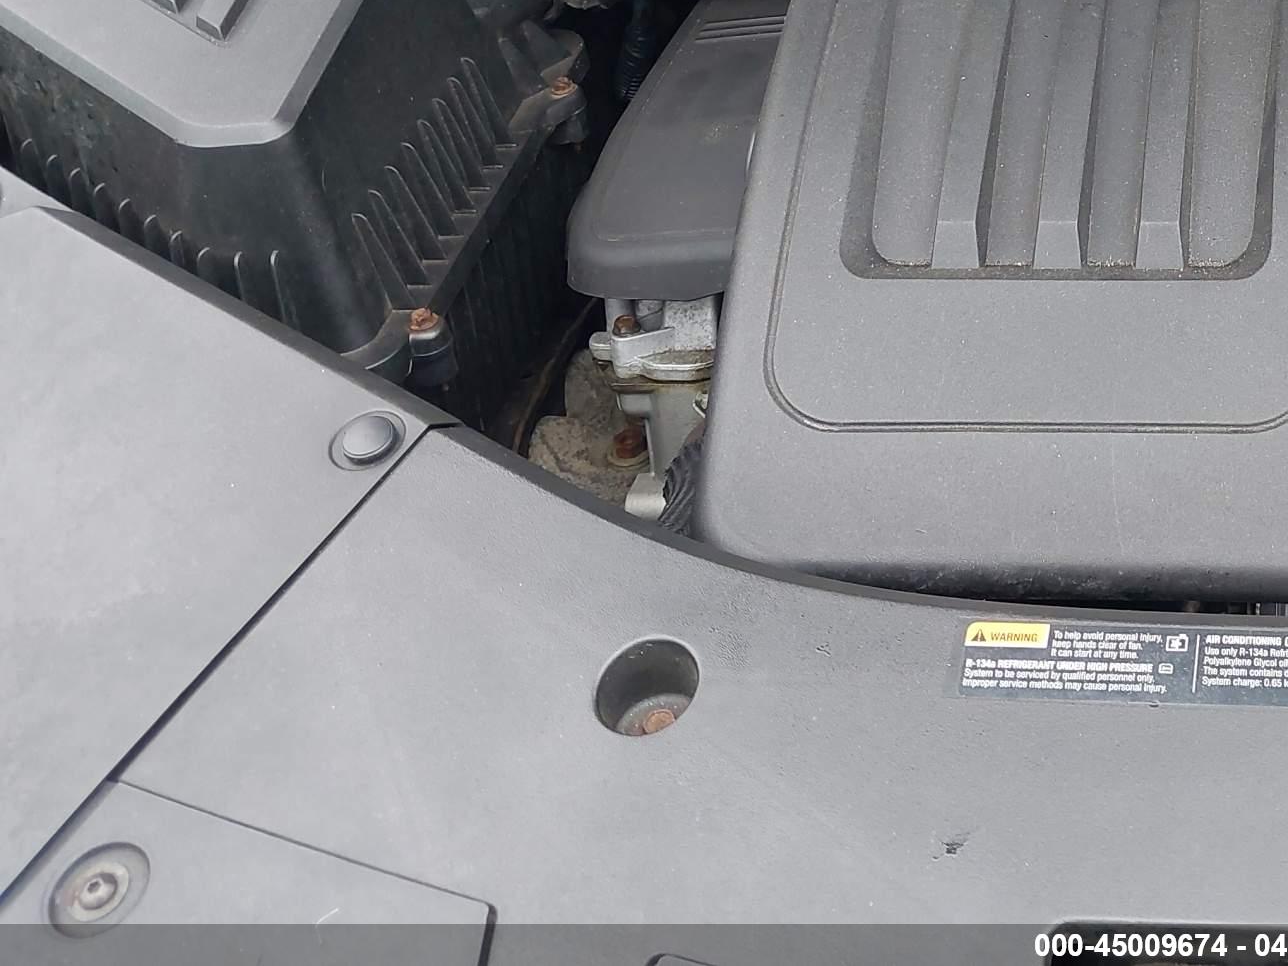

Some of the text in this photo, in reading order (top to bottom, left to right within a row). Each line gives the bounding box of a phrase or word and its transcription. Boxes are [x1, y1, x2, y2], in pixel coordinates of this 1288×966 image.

[990, 632, 1039, 642] WARNING
[1053, 630, 1062, 640] To
[1064, 630, 1081, 641] help
[1082, 632, 1104, 640] avoid
[1105, 632, 1138, 642] personal
[1206, 634, 1282, 646] AIR CONDITIONING
[1052, 640, 1072, 649] keep
[1073, 640, 1096, 649] hands
[1098, 641, 1117, 650] clear
[1118, 641, 1128, 650] of
[1074, 650, 1092, 658] start
[1093, 650, 1102, 658] at
[1103, 651, 1118, 660] any
[1120, 651, 1139, 659] time.
[1204, 646, 1220, 656] Use
[1221, 648, 1238, 657] only
[1240, 648, 1268, 657] R-134a
[966, 658, 1154, 672] R-134a REFRIGERANT UNDER HIGH PRESSURE
[1254, 658, 1277, 668] Glycol
[1279, 658, 1288, 667] oil
[964, 668, 994, 678] System
[995, 669, 1003, 678] to
[1004, 670, 1014, 678] be
[1016, 670, 1050, 679] serviced
[1051, 671, 1060, 680] by
[1062, 671, 1096, 681] qualified
[1097, 672, 1136, 682] personnel
[1203, 666, 1218, 675] The
[1220, 667, 1248, 677] system
[1249, 668, 1282, 677] contains
[962, 678, 998, 688] Improper
[999, 680, 1028, 688] service
[1029, 680, 1063, 690] methods
[1064, 682, 1082, 692] may
[1083, 682, 1107, 691] cause
[1108, 682, 1142, 692] personal
[1202, 676, 1231, 686] System
[1232, 677, 1262, 688] charge:
[1264, 678, 1282, 687] 0.65
